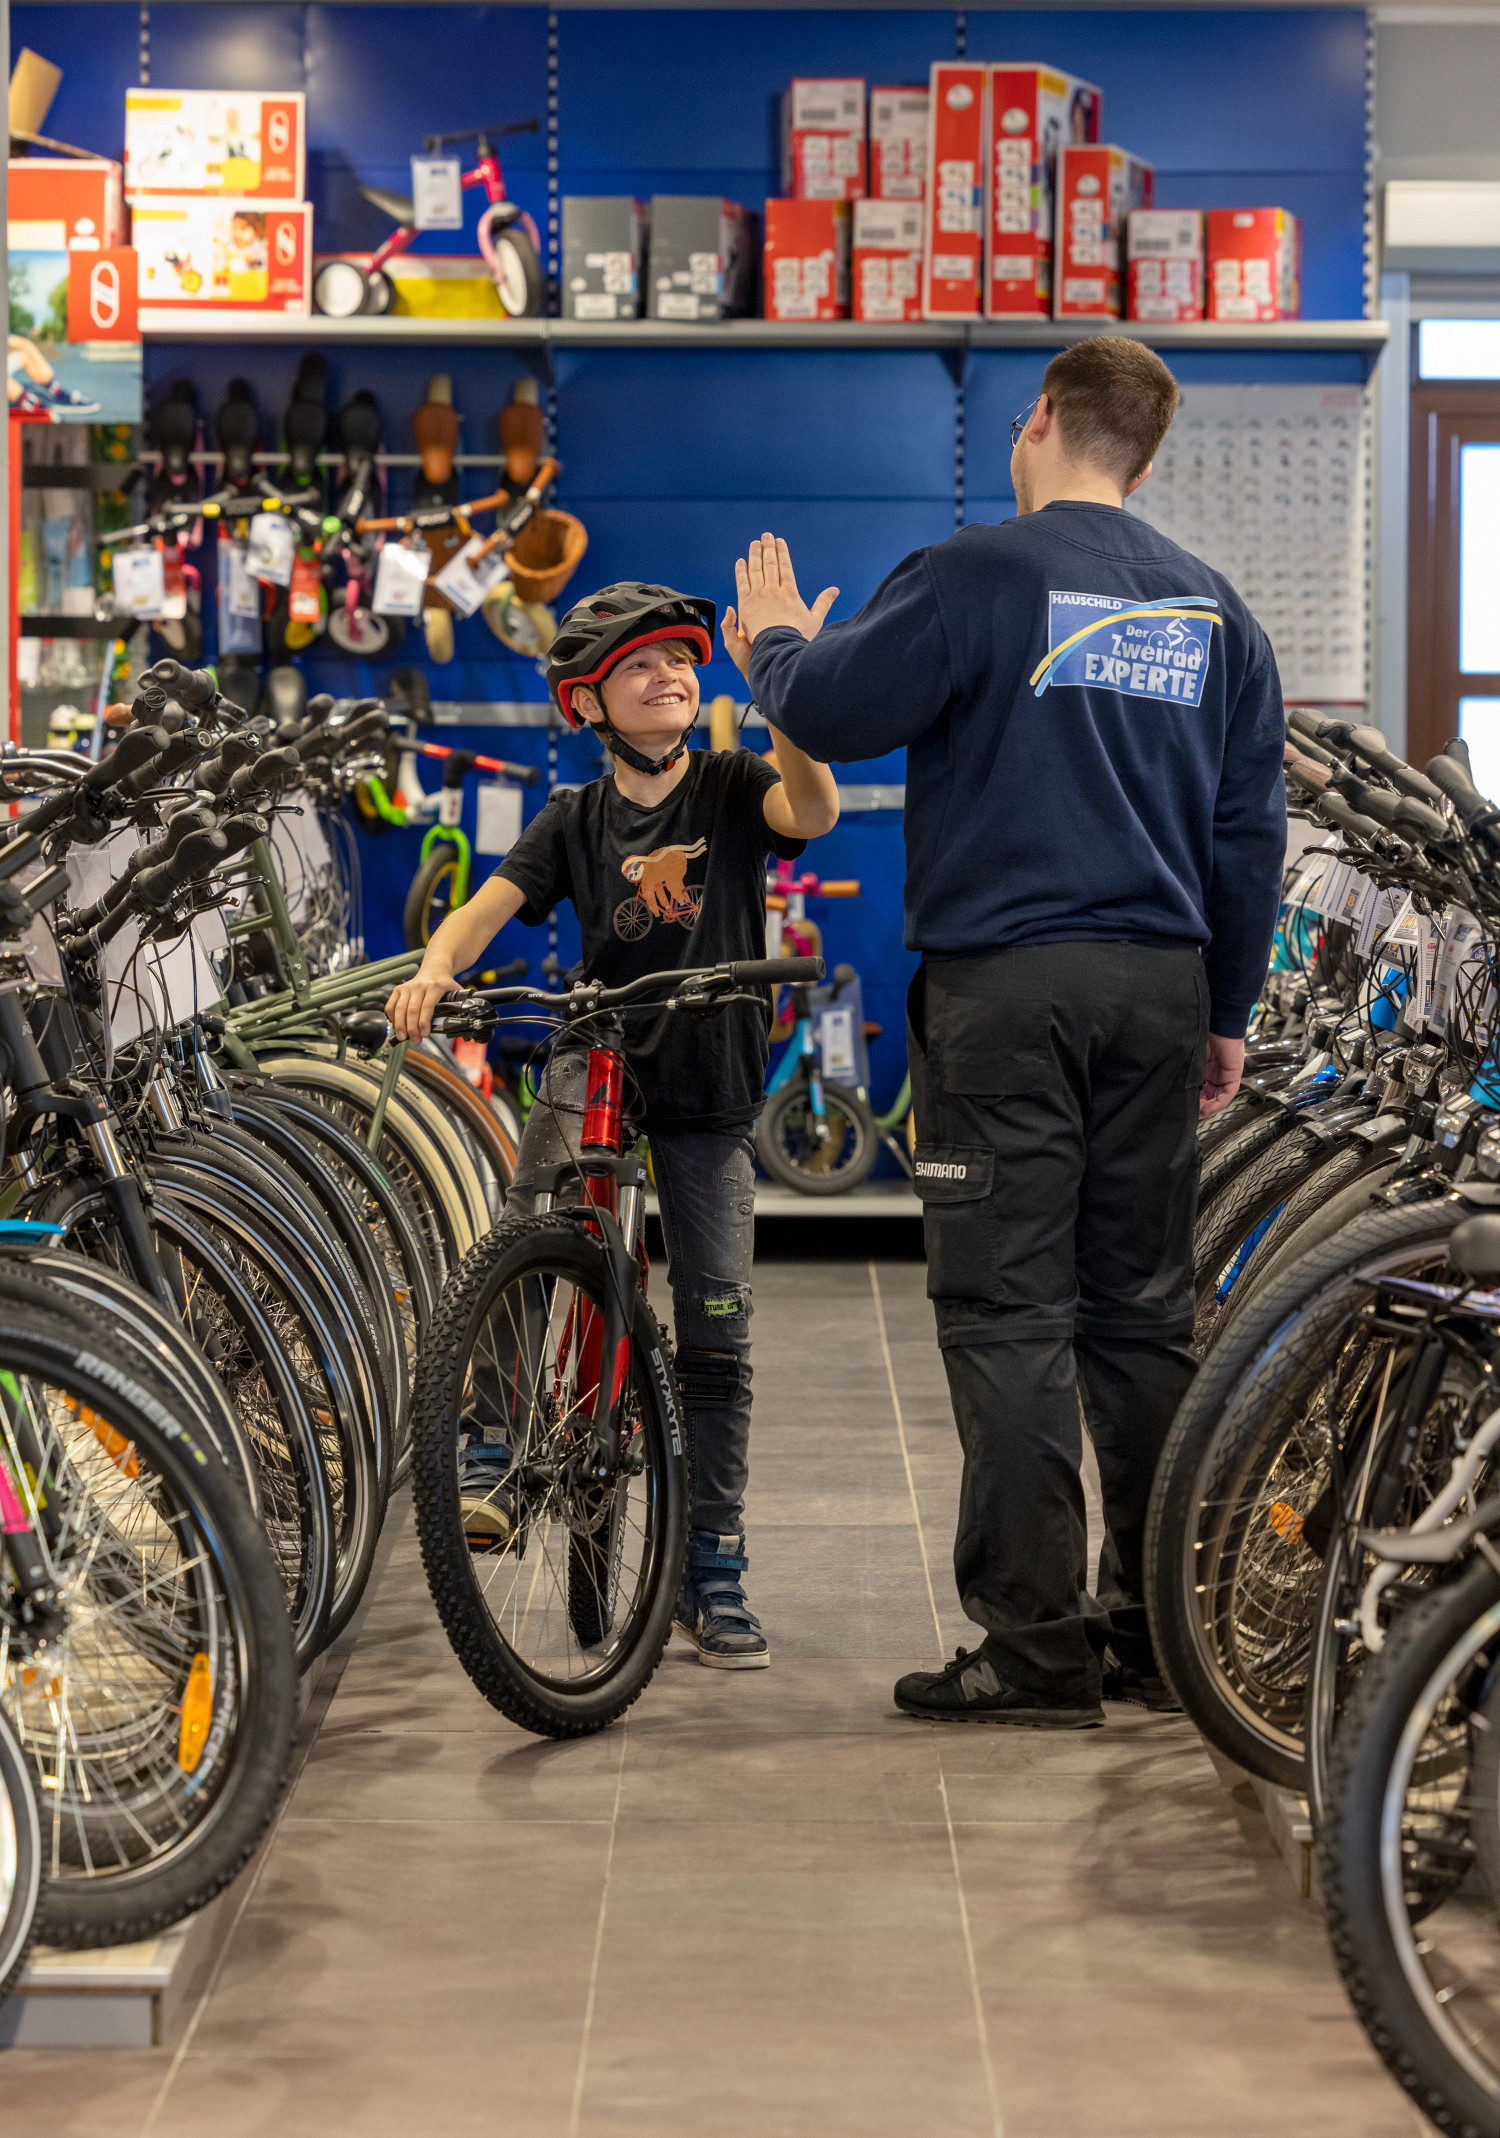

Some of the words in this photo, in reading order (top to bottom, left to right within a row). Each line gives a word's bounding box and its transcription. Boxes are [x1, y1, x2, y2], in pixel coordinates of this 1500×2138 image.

[1052, 594, 1122, 610] HAUSCHILD
[1125, 624, 1149, 639] Der
[1111, 633, 1202, 671] Zweirad
[1085, 653, 1198, 700] EXPERTE
[915, 1161, 967, 1179] SHIMANO
[74, 1351, 183, 1440] RANGER
